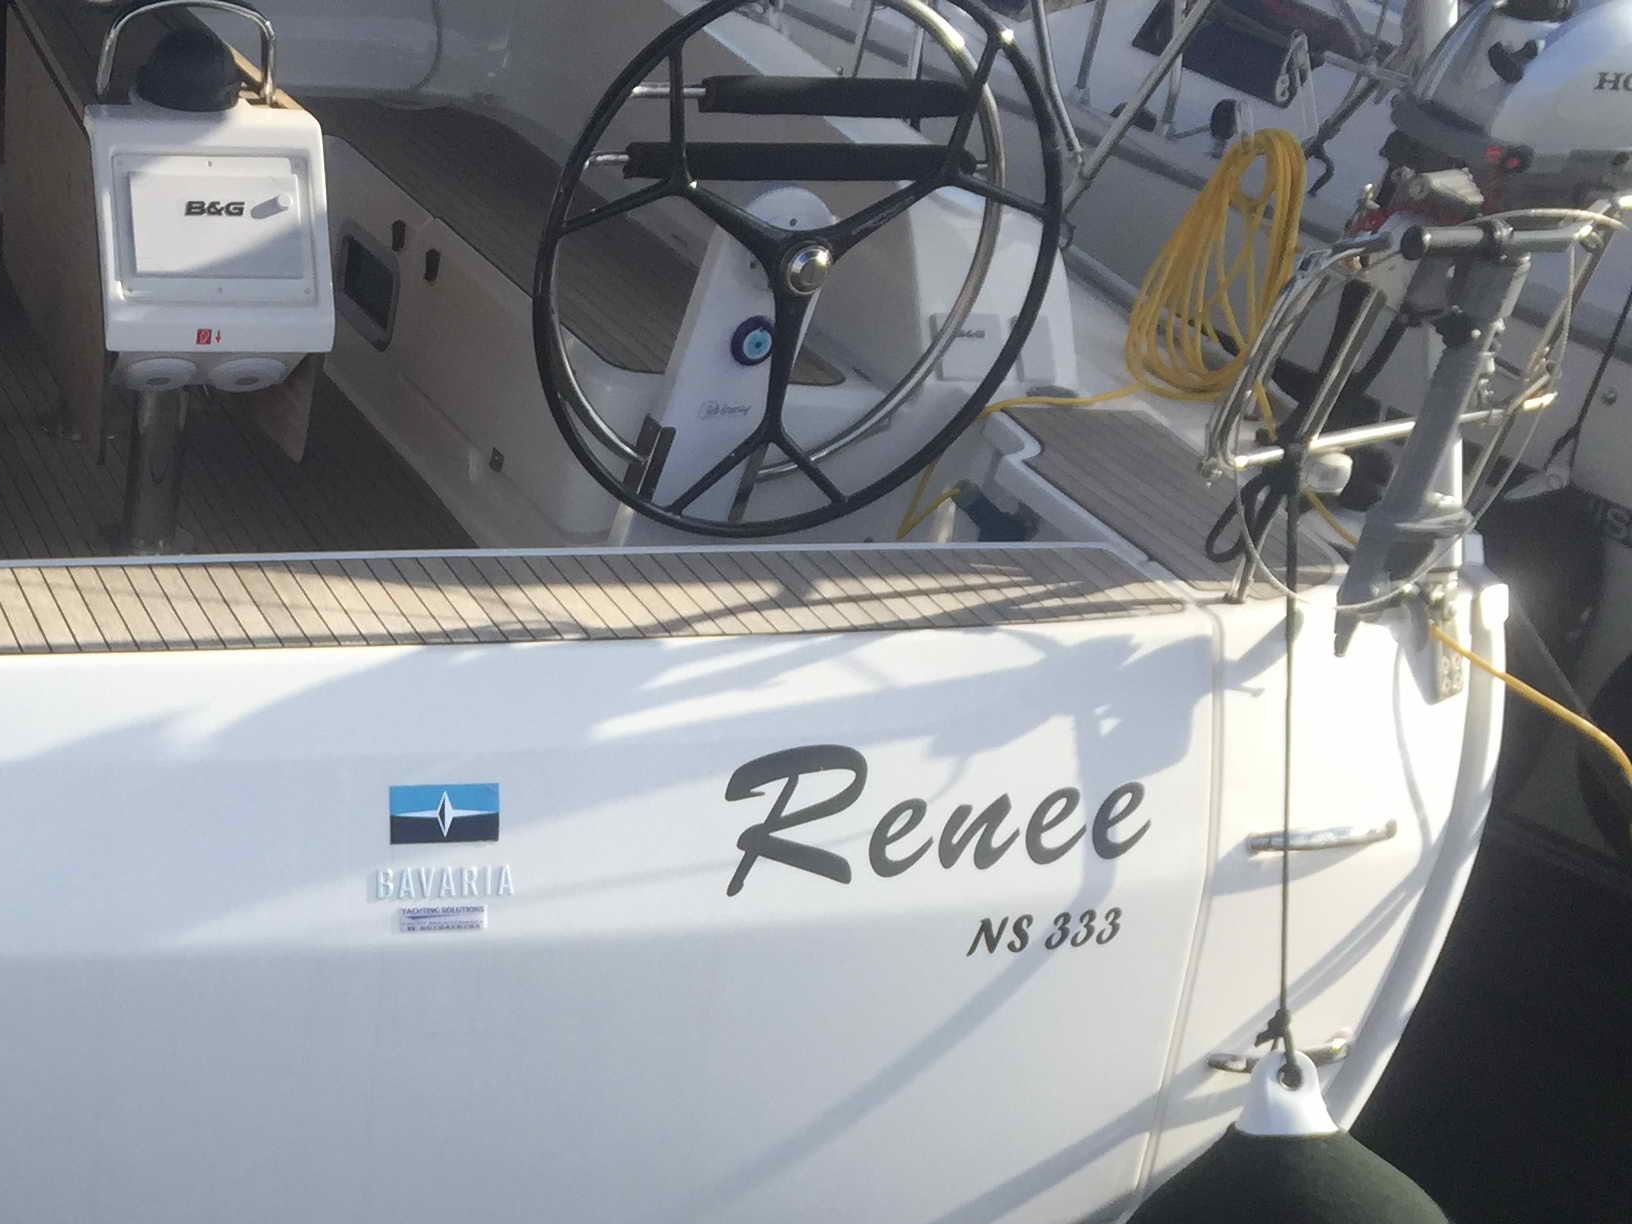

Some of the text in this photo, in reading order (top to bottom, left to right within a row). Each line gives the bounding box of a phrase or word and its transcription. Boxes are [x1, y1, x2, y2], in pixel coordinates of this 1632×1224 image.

[184, 200, 245, 217] B&G
[725, 743, 1152, 897] Renee
[376, 865, 515, 899] BAVARIA
[967, 907, 1123, 957] NS 333
